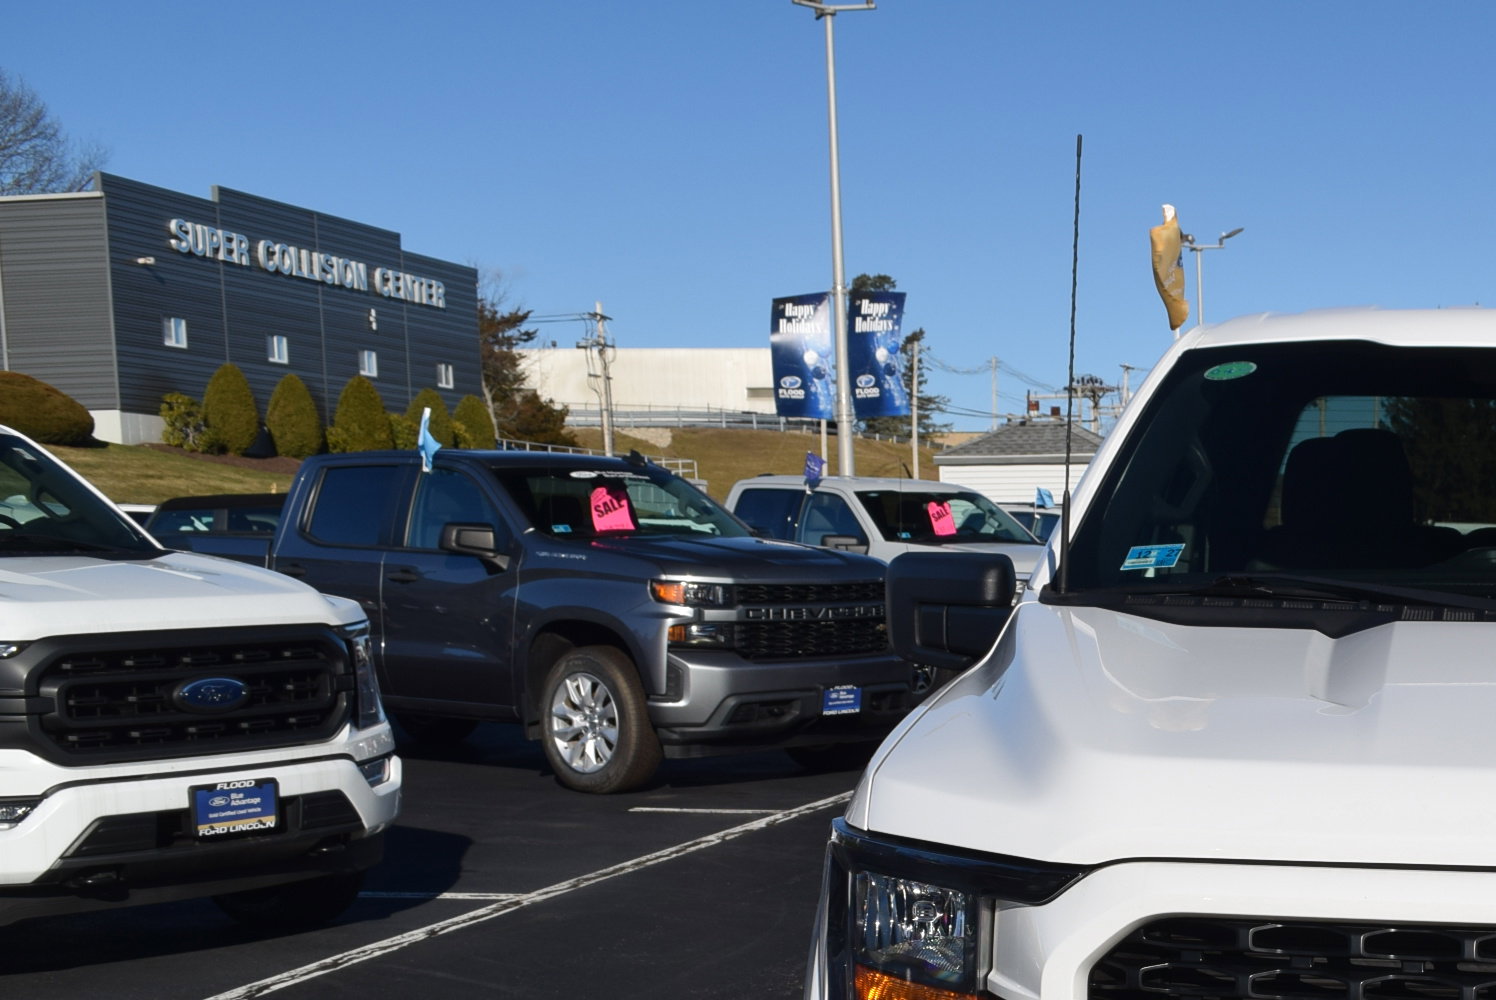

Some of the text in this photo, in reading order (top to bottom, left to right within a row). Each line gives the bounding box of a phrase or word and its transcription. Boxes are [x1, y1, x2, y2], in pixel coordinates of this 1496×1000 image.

[169, 218, 446, 308] SUPER COLLISION CENTER
[785, 302, 815, 319] Happy
[861, 299, 890, 317] Happy
[779, 318, 822, 334] Holidays
[855, 316, 894, 333] Holidays
[594, 496, 624, 518] SALE
[1136, 550, 1151, 559] 12
[746, 605, 885, 620] CHEVROLE
[216, 780, 255, 791] FLOOD
[199, 820, 276, 837] FORD LINCOLN
